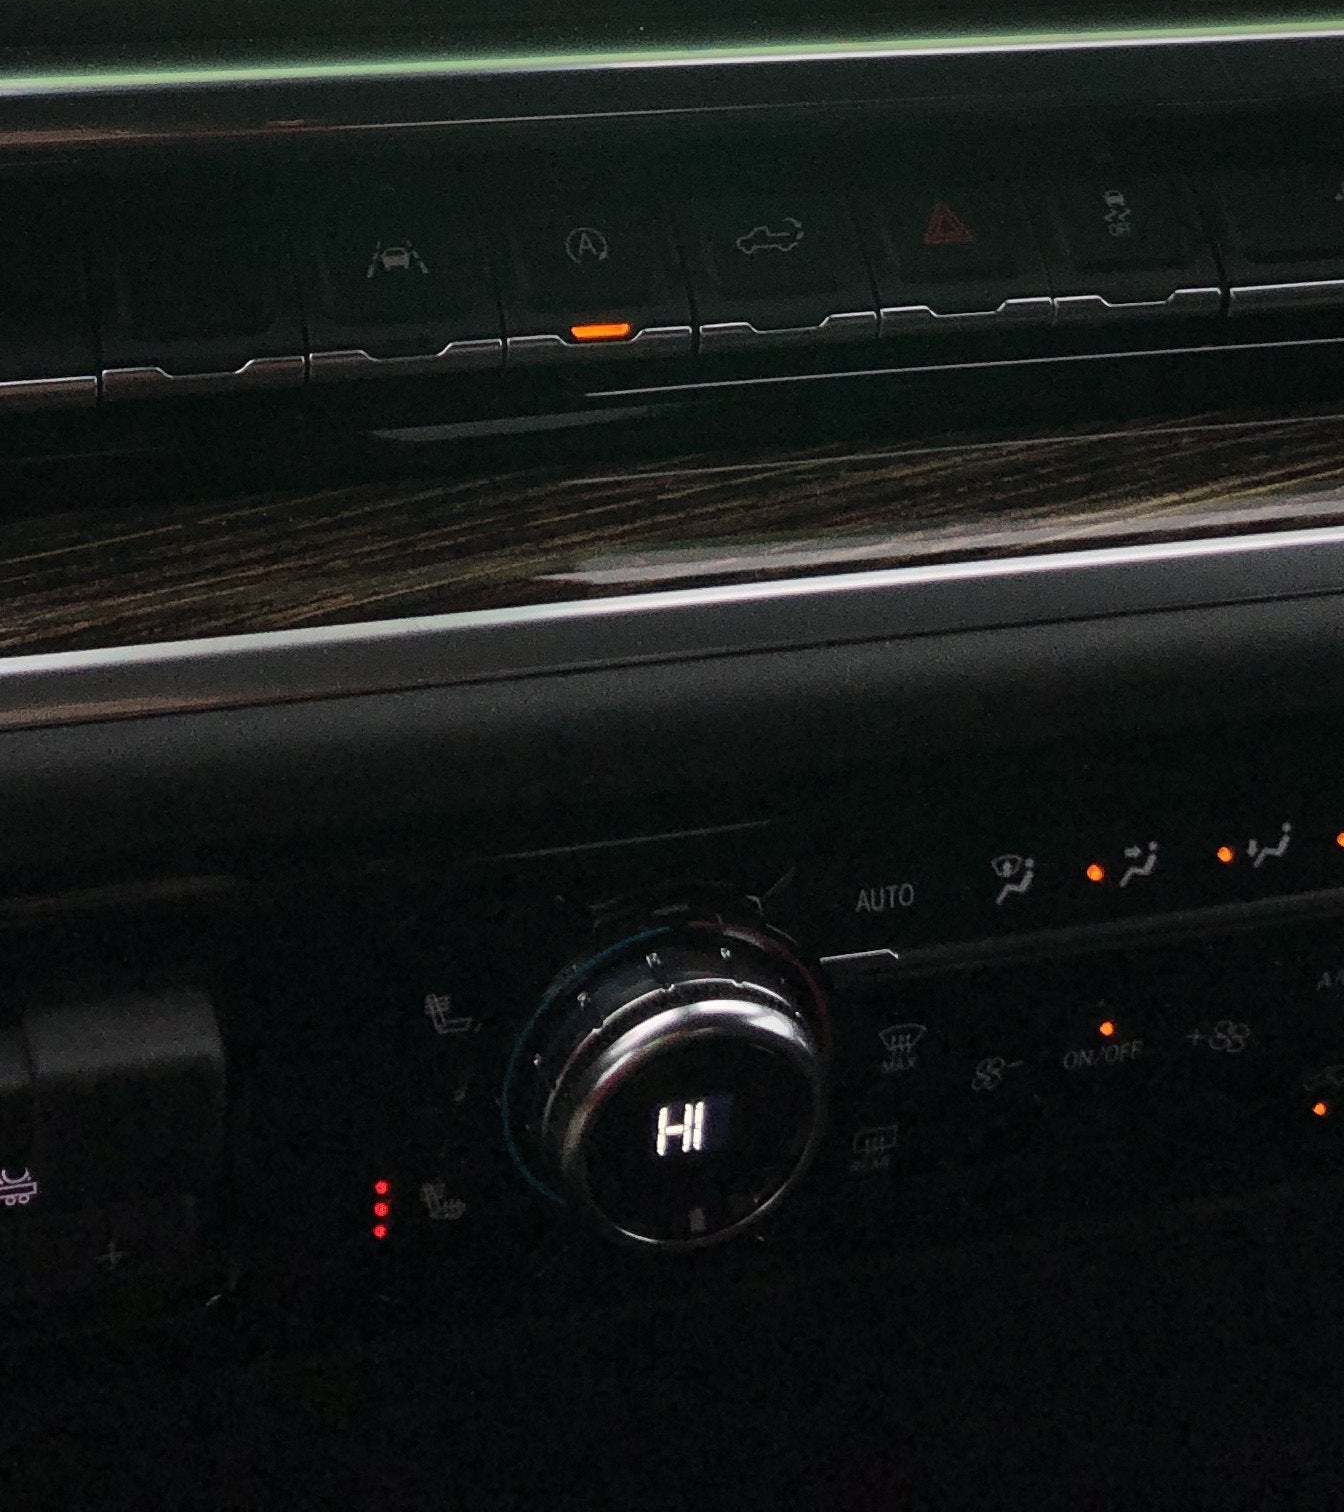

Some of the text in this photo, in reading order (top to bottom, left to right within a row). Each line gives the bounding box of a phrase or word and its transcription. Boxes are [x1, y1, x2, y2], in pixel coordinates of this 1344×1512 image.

[856, 882, 915, 914] AUTO
[1062, 1038, 1145, 1072] ON/OFF
[655, 1099, 708, 1158] HI
